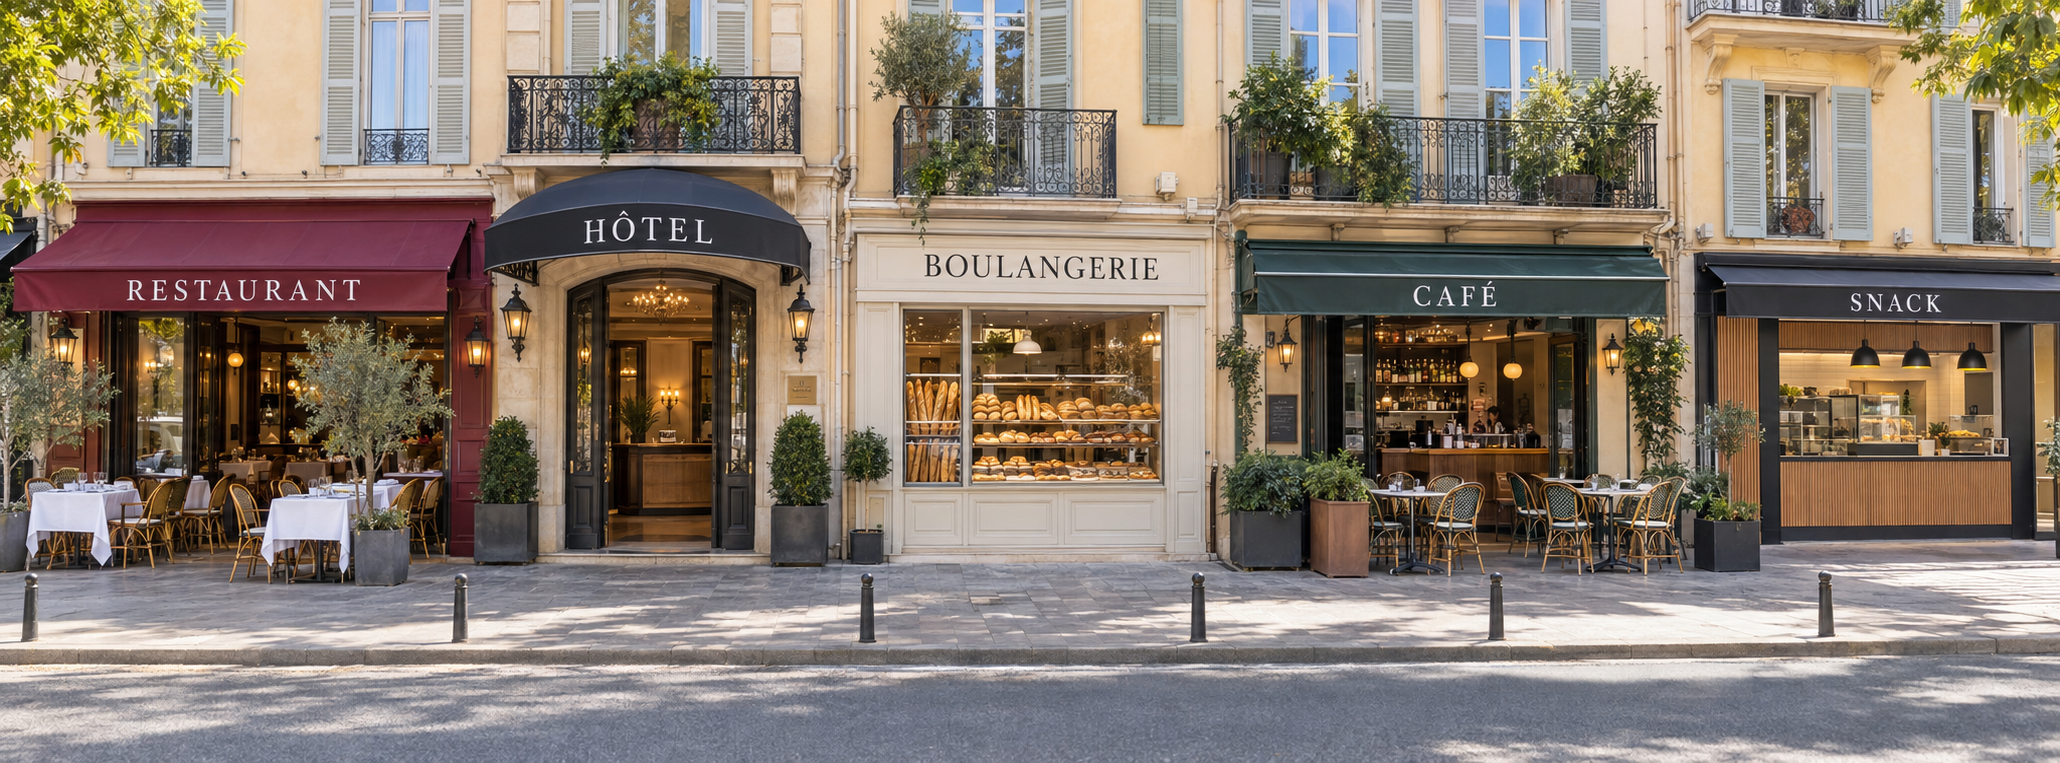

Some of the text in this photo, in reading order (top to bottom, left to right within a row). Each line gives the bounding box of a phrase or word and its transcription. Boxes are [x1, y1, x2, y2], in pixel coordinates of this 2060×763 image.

[584, 211, 713, 244] HÔTEL
[925, 254, 1159, 280] BOULANGERIE
[126, 279, 361, 302] RESTAURANT
[1413, 280, 1497, 307] CAFÉ
[1850, 293, 1942, 313] SNACK
